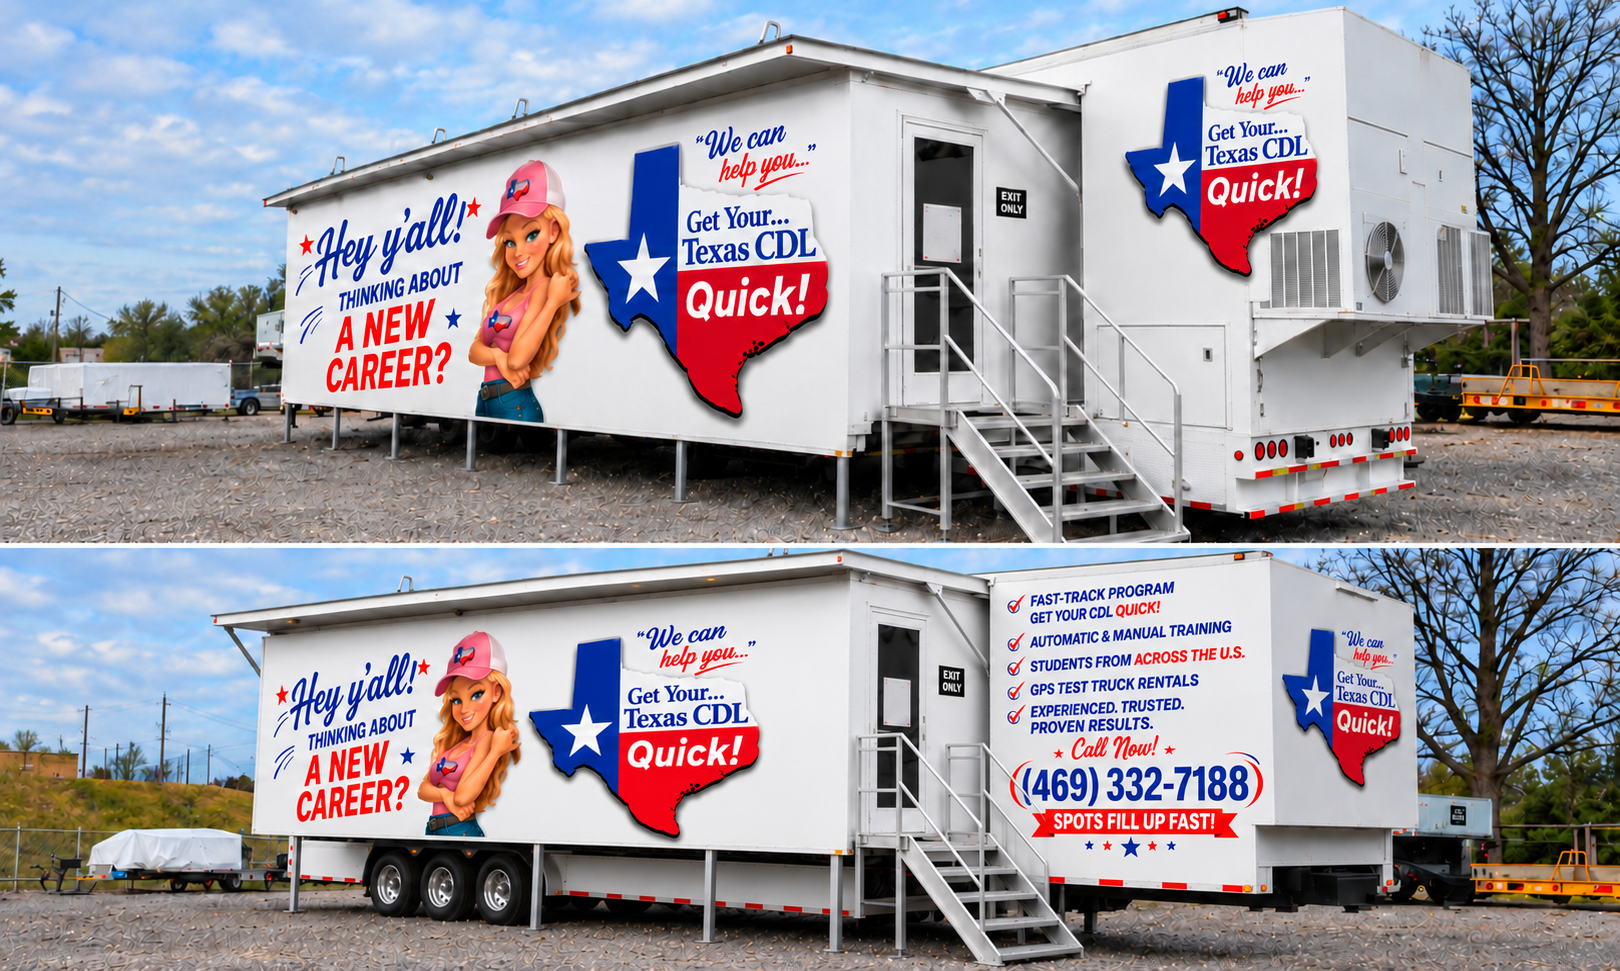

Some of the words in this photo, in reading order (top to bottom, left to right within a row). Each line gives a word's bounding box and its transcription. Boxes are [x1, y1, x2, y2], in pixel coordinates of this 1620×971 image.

[1258, 62, 1288, 80] can
[1235, 83, 1264, 109] help
[747, 125, 786, 149] can
[1208, 124, 1235, 142] Get
[1238, 121, 1288, 138] Your...
[1205, 145, 1258, 166] Texas
[1262, 135, 1308, 159] CDL
[719, 153, 757, 188] help
[1001, 191, 1021, 202] EXIT
[1207, 168, 1304, 208] Quick!
[687, 210, 720, 233] Get
[724, 206, 789, 229] Your...
[1000, 203, 1023, 214] ONLY
[315, 219, 377, 287] Hey
[380, 193, 466, 275] y'all!
[682, 237, 750, 265] Texas
[755, 228, 817, 260] CDL
[339, 278, 404, 312] THINKING
[408, 261, 463, 295] ABOUT
[686, 273, 810, 322] Quick!
[335, 315, 354, 353] A
[363, 298, 436, 348] NEW
[326, 341, 452, 393] CAREER?
[1030, 588, 1105, 607] FAST-TRACK
[1108, 581, 1175, 600] PROGRAM
[1030, 610, 1053, 624] GET
[1055, 607, 1087, 623] YOUR
[1089, 605, 1113, 620] CDL
[1115, 601, 1161, 618] QUICK!
[688, 625, 727, 643] can
[1030, 630, 1099, 648] AUTOMATIC
[1102, 629, 1110, 642] &
[1113, 626, 1167, 642] MANUAL
[1169, 620, 1232, 637] TRAINING
[1366, 639, 1384, 649] can
[659, 645, 698, 673] help
[1030, 656, 1093, 672] STUDENTS
[1096, 654, 1132, 668] FROM
[1134, 649, 1188, 666] ACROSS
[1191, 647, 1217, 662] THE
[1220, 646, 1246, 660] U.S.
[942, 682, 962, 693] ONLY
[943, 670, 960, 681] EXIT
[1030, 682, 1055, 696] GPS
[1058, 680, 1088, 694] TEST
[1091, 678, 1135, 693] TRUCK
[1138, 674, 1199, 690] RENTALS
[1337, 670, 1354, 684] Get
[1356, 673, 1384, 690] Your...
[290, 671, 344, 731] Hey
[346, 652, 417, 721] y'all!
[627, 687, 660, 705] Get
[664, 685, 724, 702] Your...
[1336, 685, 1368, 704] Texas
[1370, 690, 1396, 708] CDL
[624, 708, 687, 728] Texas
[693, 702, 749, 725] CDL
[1030, 701, 1118, 718] EXPERIENCED.
[1121, 698, 1185, 713] TRUSTED.
[308, 721, 366, 751] THINKING
[369, 709, 416, 737] ABOUT
[1030, 720, 1085, 735] PROVEN
[1088, 716, 1153, 732] RESULTS.
[1337, 709, 1394, 737] Quick!
[627, 735, 743, 771] Quick!
[1071, 736, 1109, 761] Call
[1113, 735, 1159, 760] Now!
[304, 754, 321, 787] A
[329, 740, 390, 783] NEW
[296, 775, 410, 823] CAREER?
[1022, 766, 1099, 807] (469)
[1106, 765, 1249, 802] 332-7188
[1054, 813, 1103, 830] SPOTS
[1107, 813, 1140, 830] FILL
[1143, 812, 1166, 829] UP
[1169, 812, 1215, 830] FAST!
